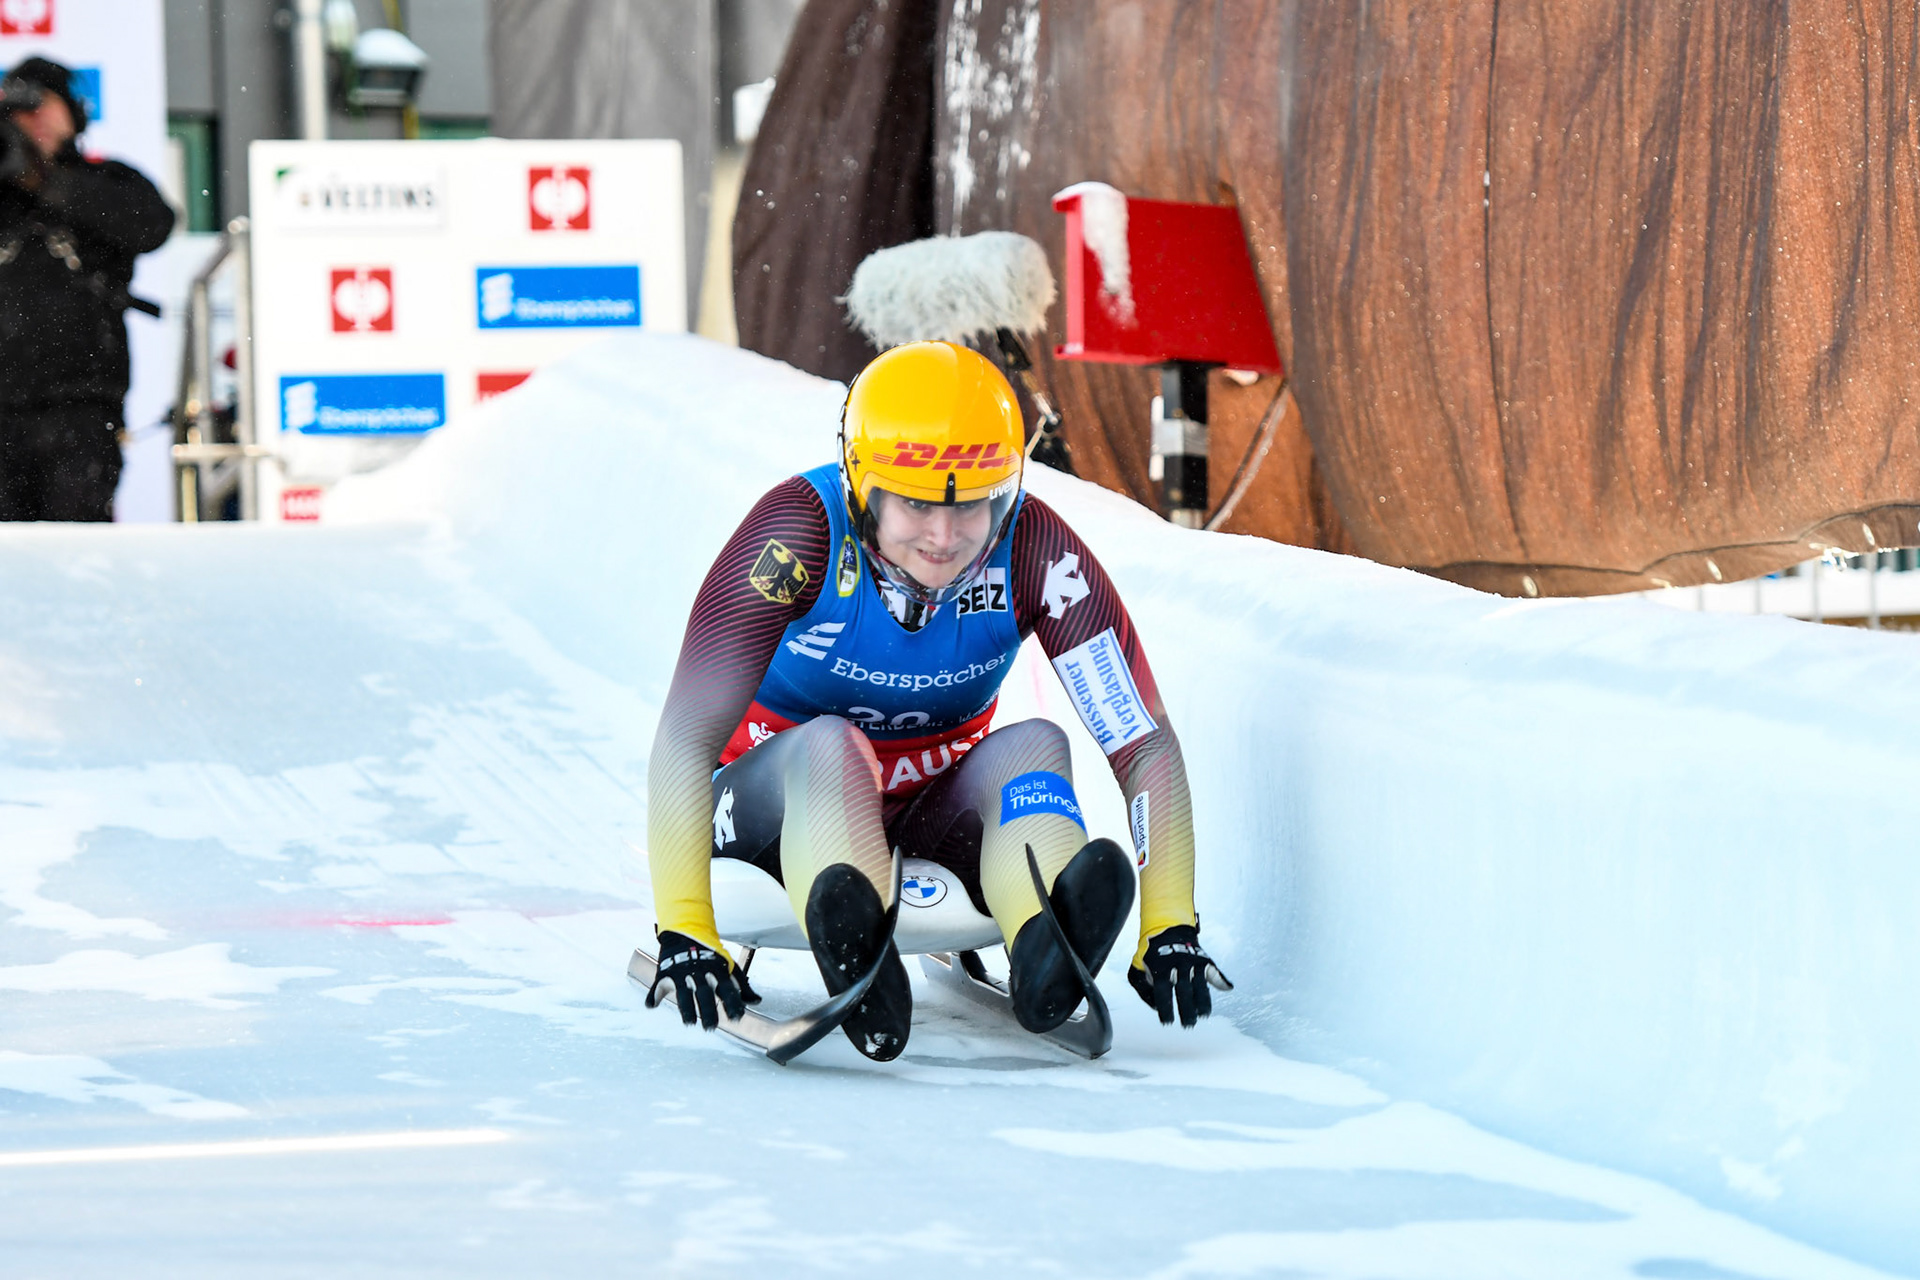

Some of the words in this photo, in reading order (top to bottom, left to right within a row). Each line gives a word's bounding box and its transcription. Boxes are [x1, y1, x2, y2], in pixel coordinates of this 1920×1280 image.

[891, 441, 1006, 471] DHL
[830, 652, 1007, 692] Eberspächer
[1088, 636, 1141, 740] Verglasung
[1064, 660, 1116, 745] Bussemer
[1009, 783, 1032, 798] Das
[1033, 780, 1048, 790] ist
[1135, 795, 1147, 850] Sporthilfe
